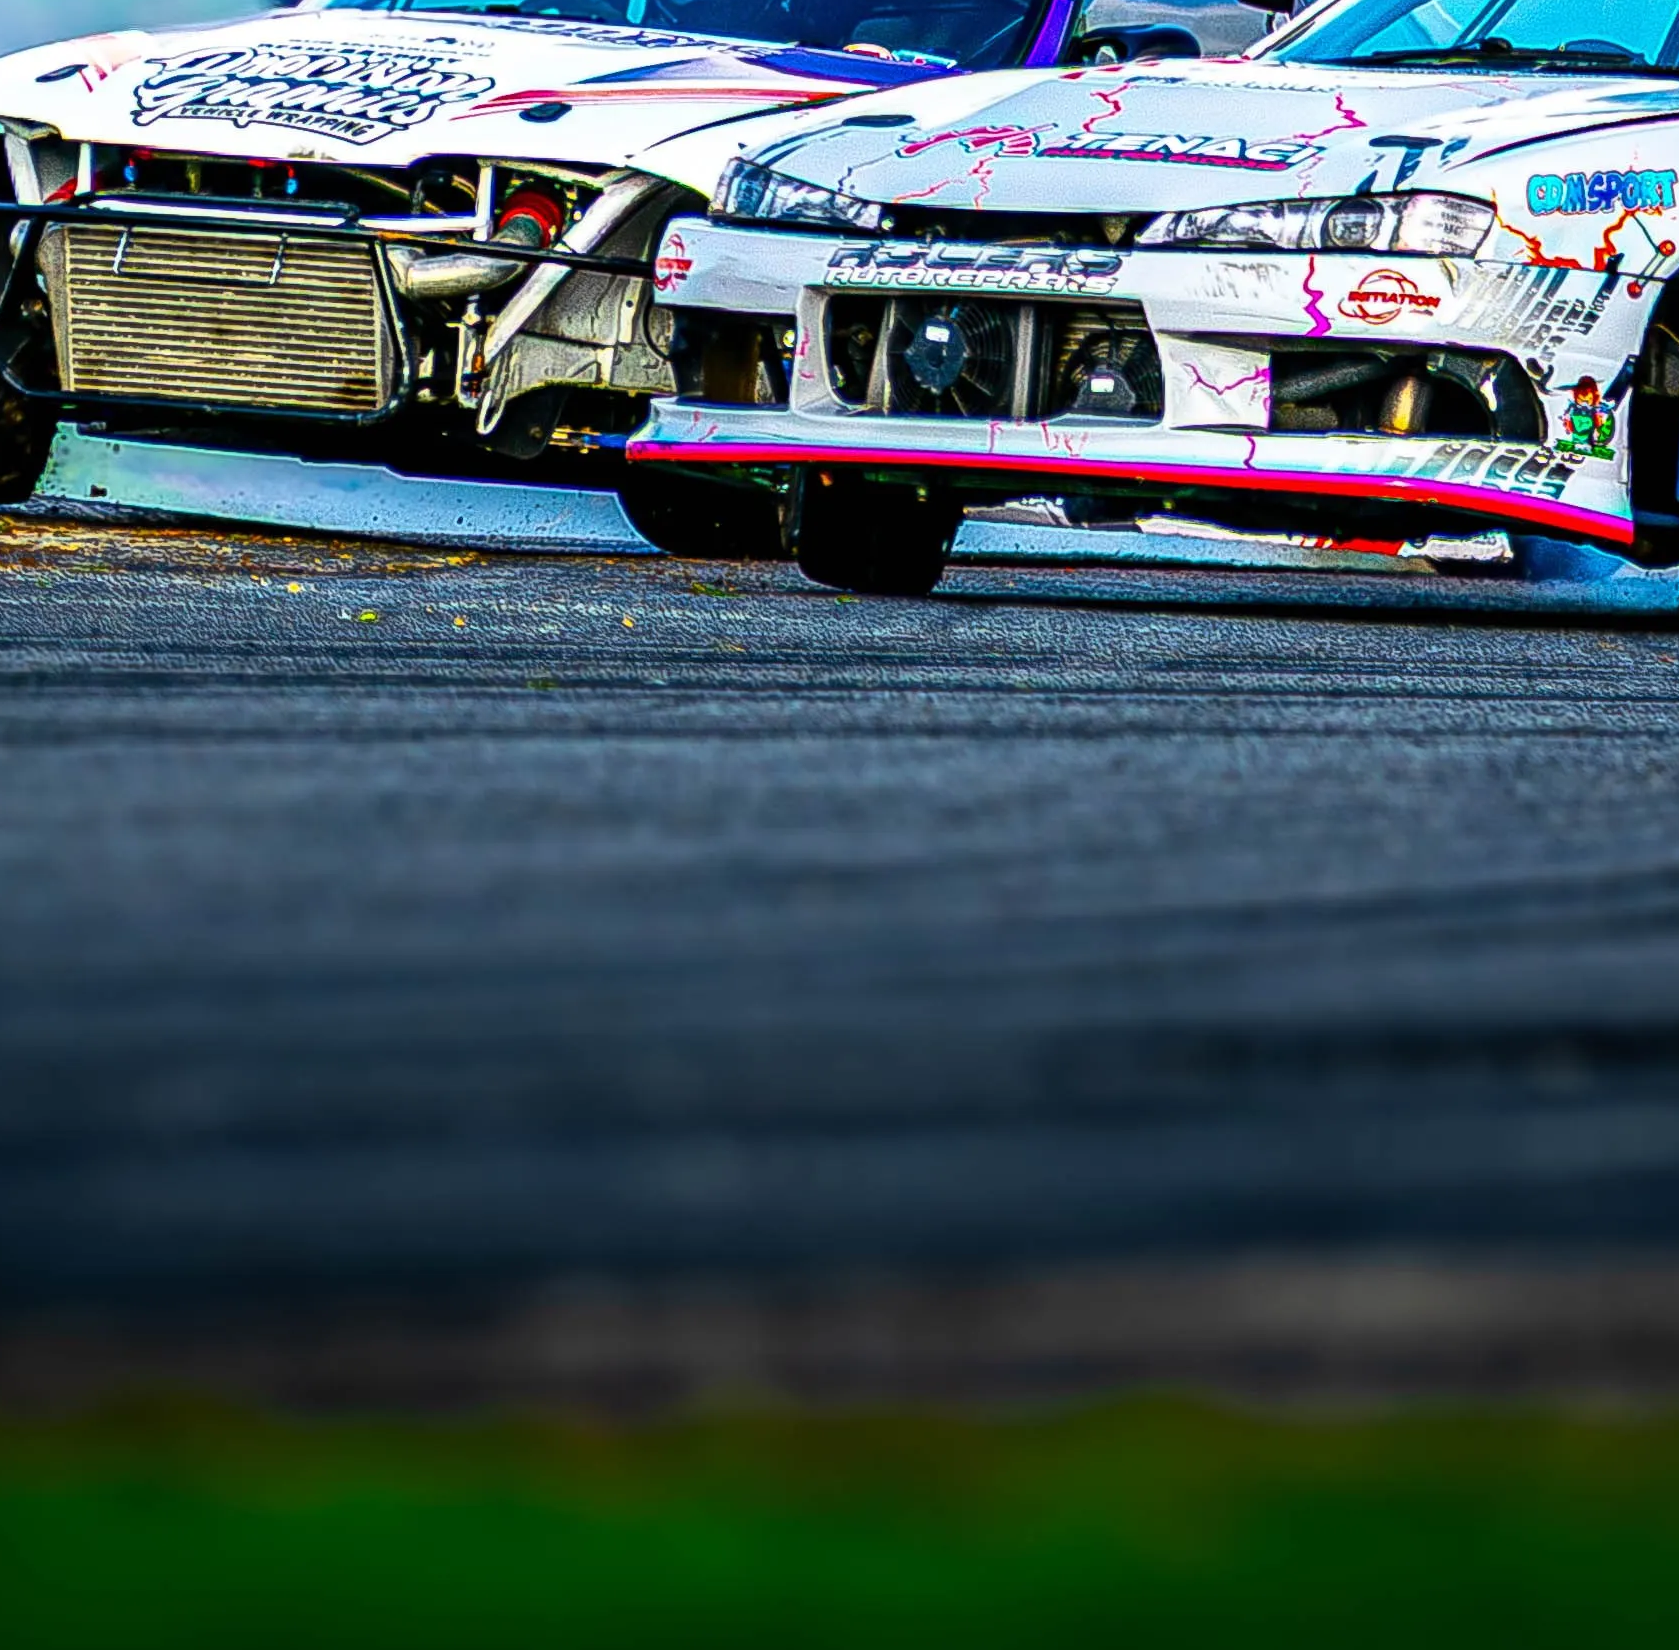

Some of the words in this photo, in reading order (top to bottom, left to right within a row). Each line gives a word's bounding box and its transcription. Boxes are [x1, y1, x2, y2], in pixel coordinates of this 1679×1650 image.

[180, 105, 264, 119] VEHICLE
[265, 109, 376, 138] WRAPPING
[1068, 131, 1324, 164] TENACI
[1348, 291, 1441, 308] INITIATION
